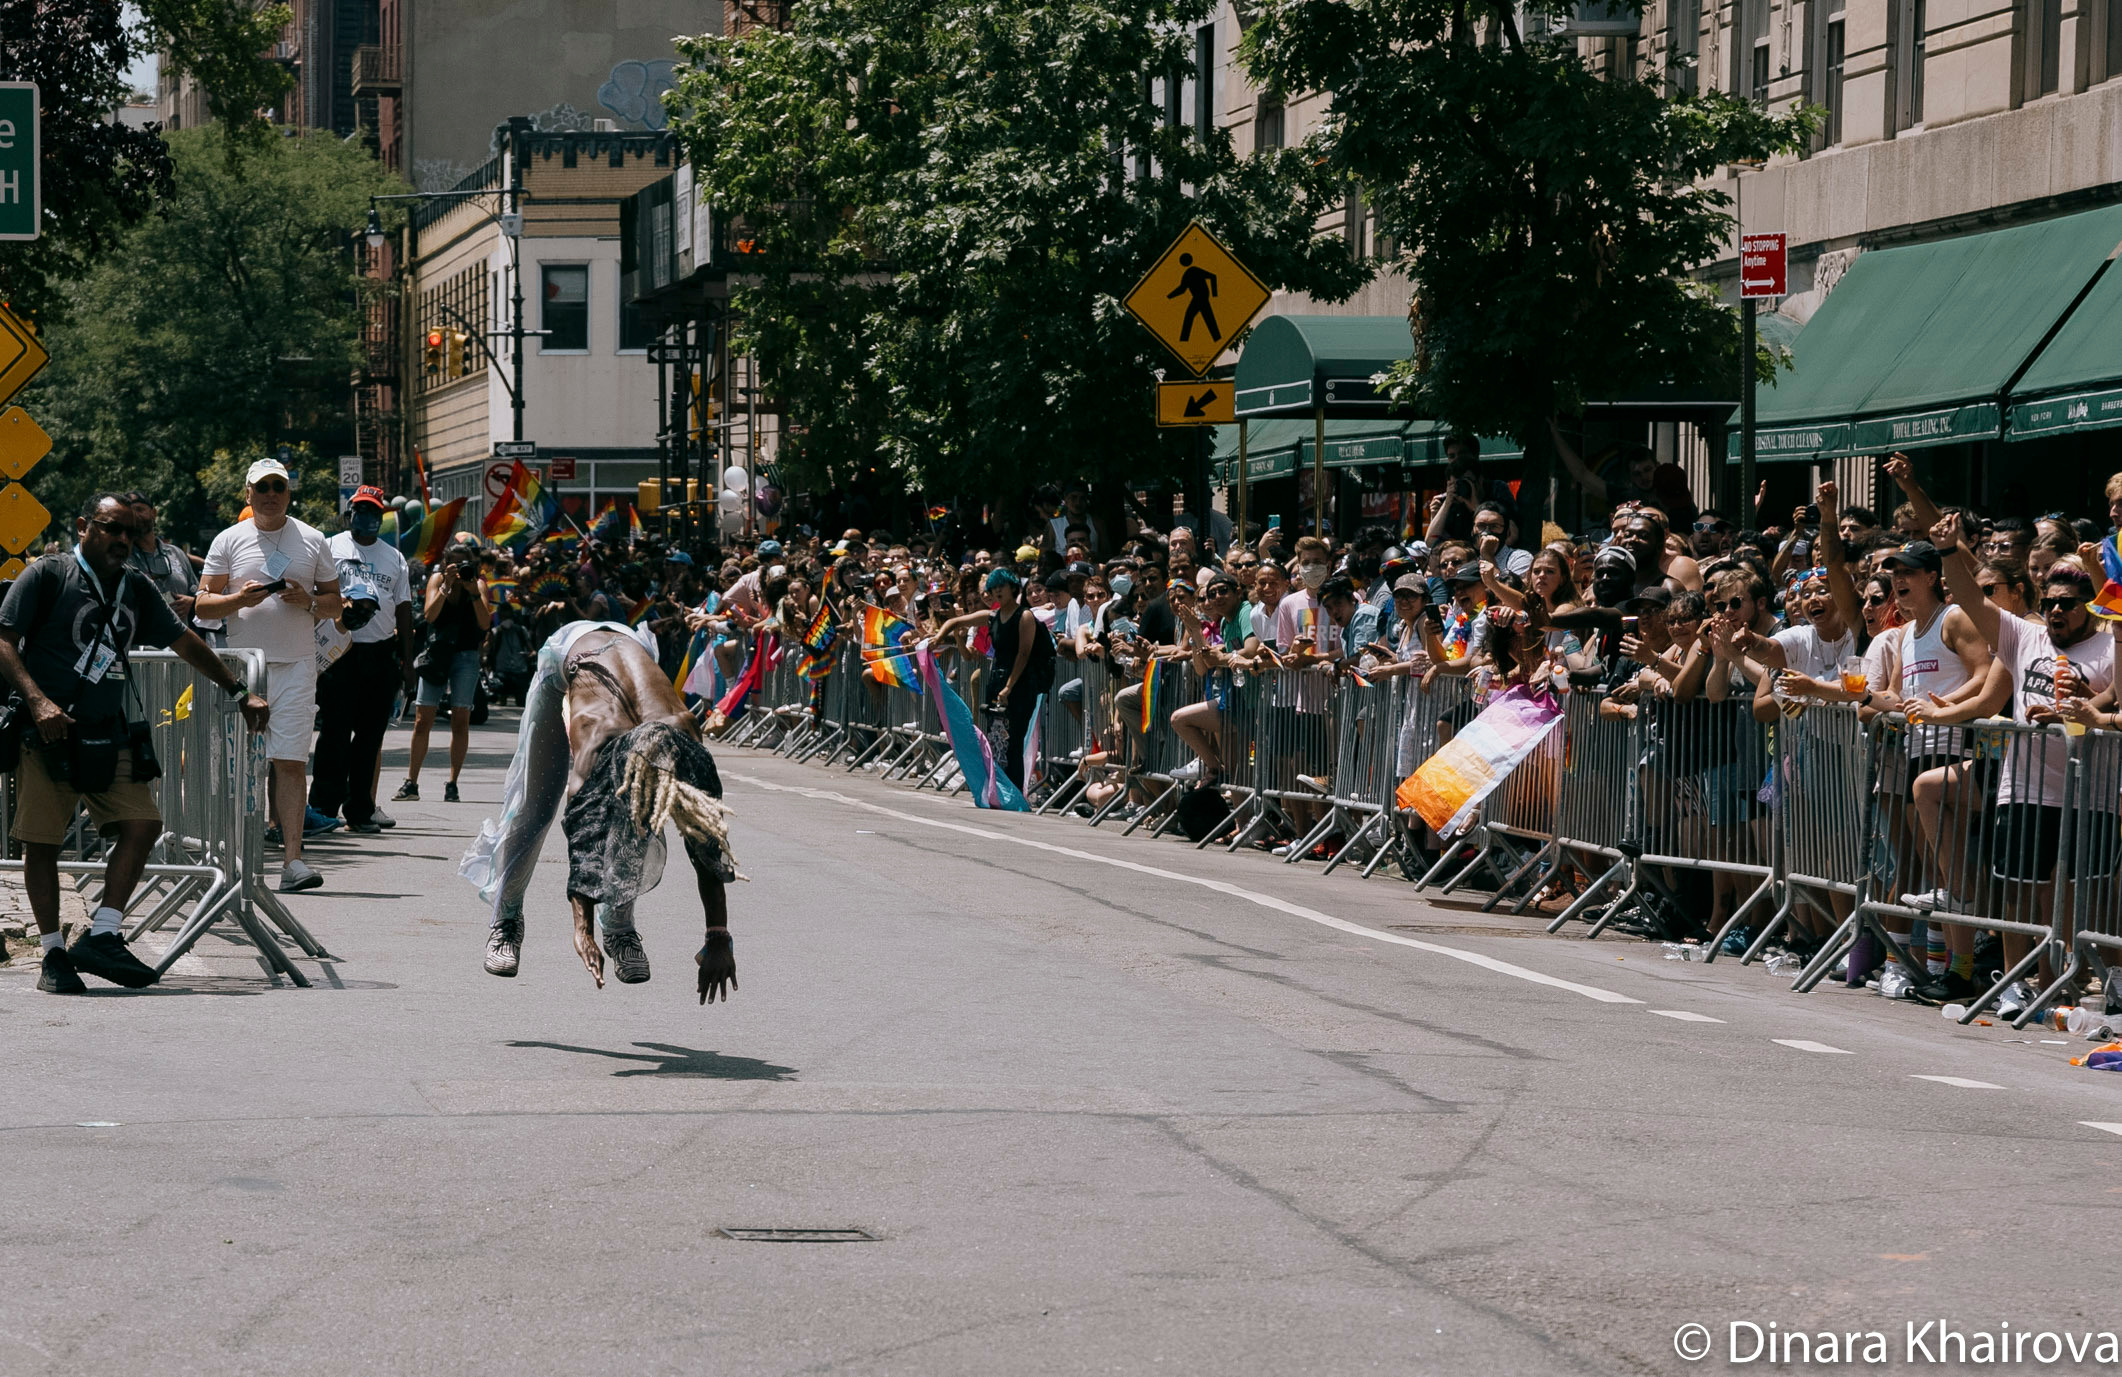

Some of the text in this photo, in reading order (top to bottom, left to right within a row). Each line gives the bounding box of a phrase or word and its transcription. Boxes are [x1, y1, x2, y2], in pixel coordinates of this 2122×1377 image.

[1743, 239, 1780, 253] NO STOPPING
[1744, 255, 1767, 269] Anytime
[1893, 422, 1912, 440] TOTAL
[1911, 417, 1939, 437] HEALING
[1755, 435, 1777, 451] ERSONAL
[1777, 433, 1796, 449] TOUCH
[343, 472, 360, 484] 20
[341, 567, 392, 585] VOLUNTEER
[2026, 675, 2055, 695] APPR
